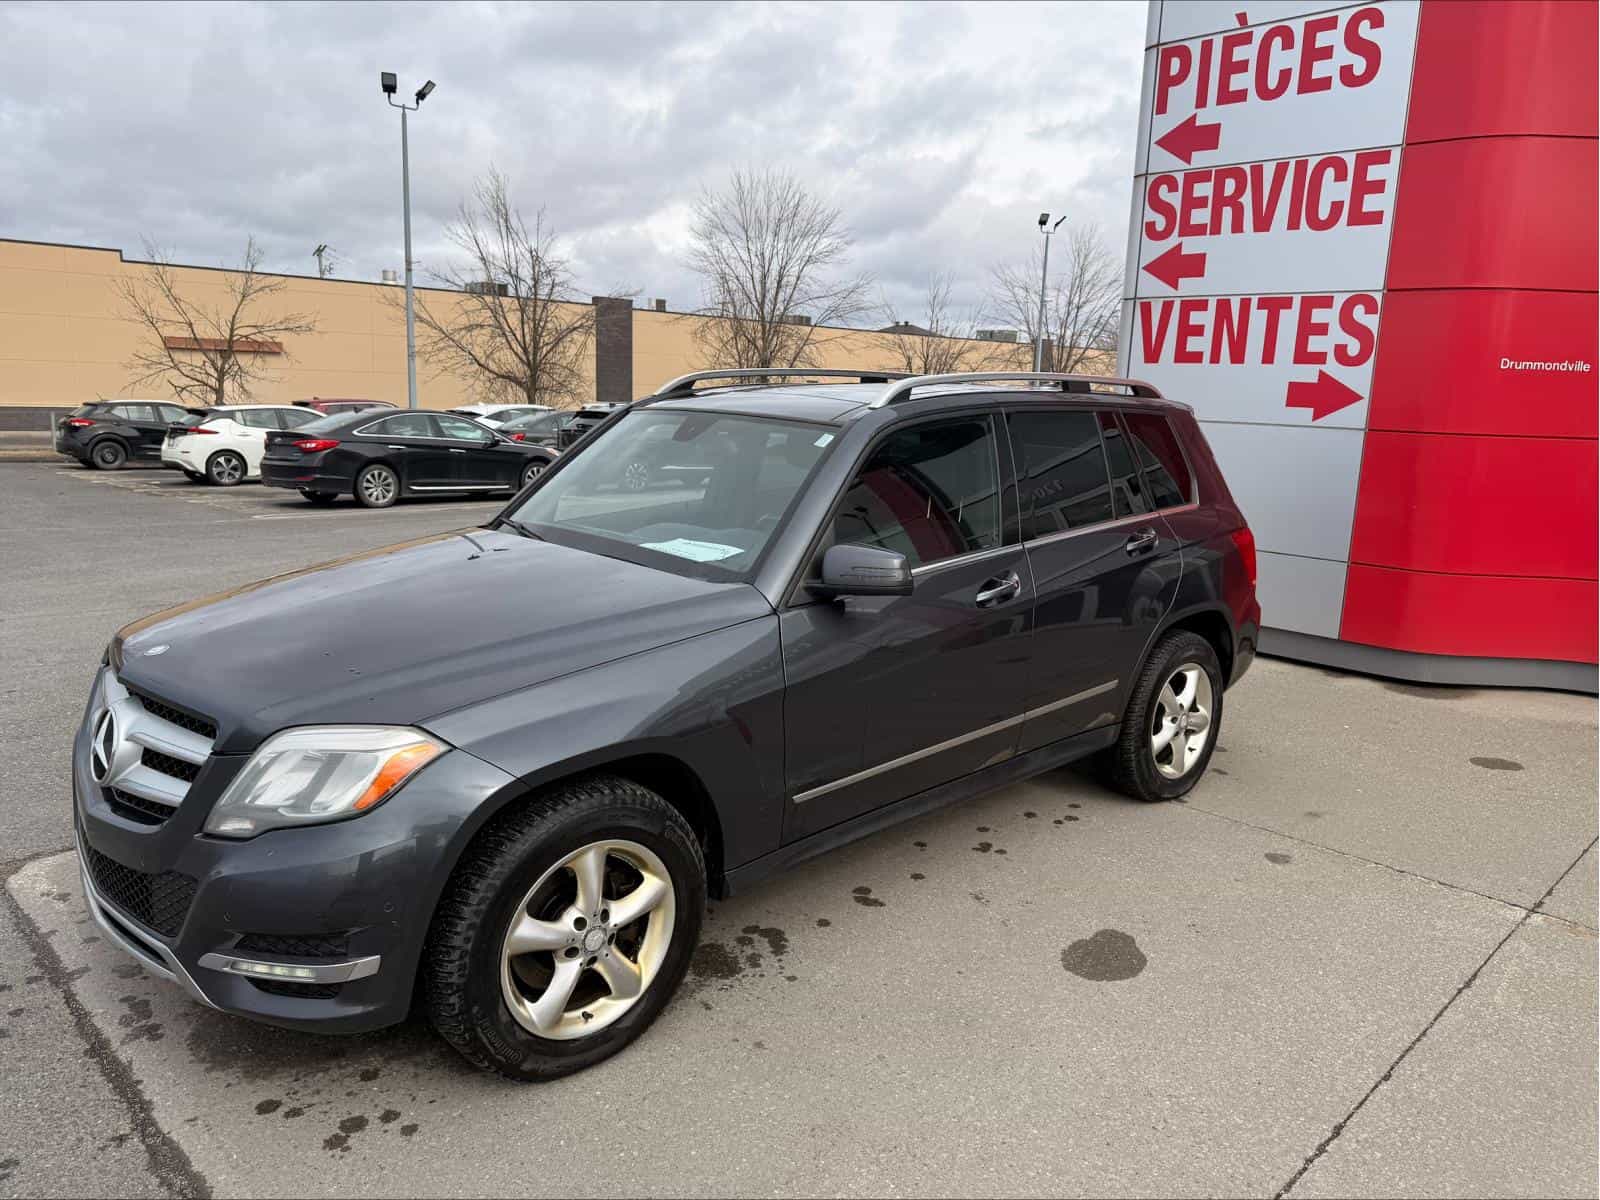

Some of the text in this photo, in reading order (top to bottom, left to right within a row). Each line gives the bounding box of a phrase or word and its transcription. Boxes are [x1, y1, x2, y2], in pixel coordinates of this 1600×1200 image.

[1155, 7, 1385, 115] PIÈCES
[1144, 149, 1392, 242] SERVICE
[1139, 293, 1379, 368] VENTES
[1500, 357, 1591, 372] Drummondville
